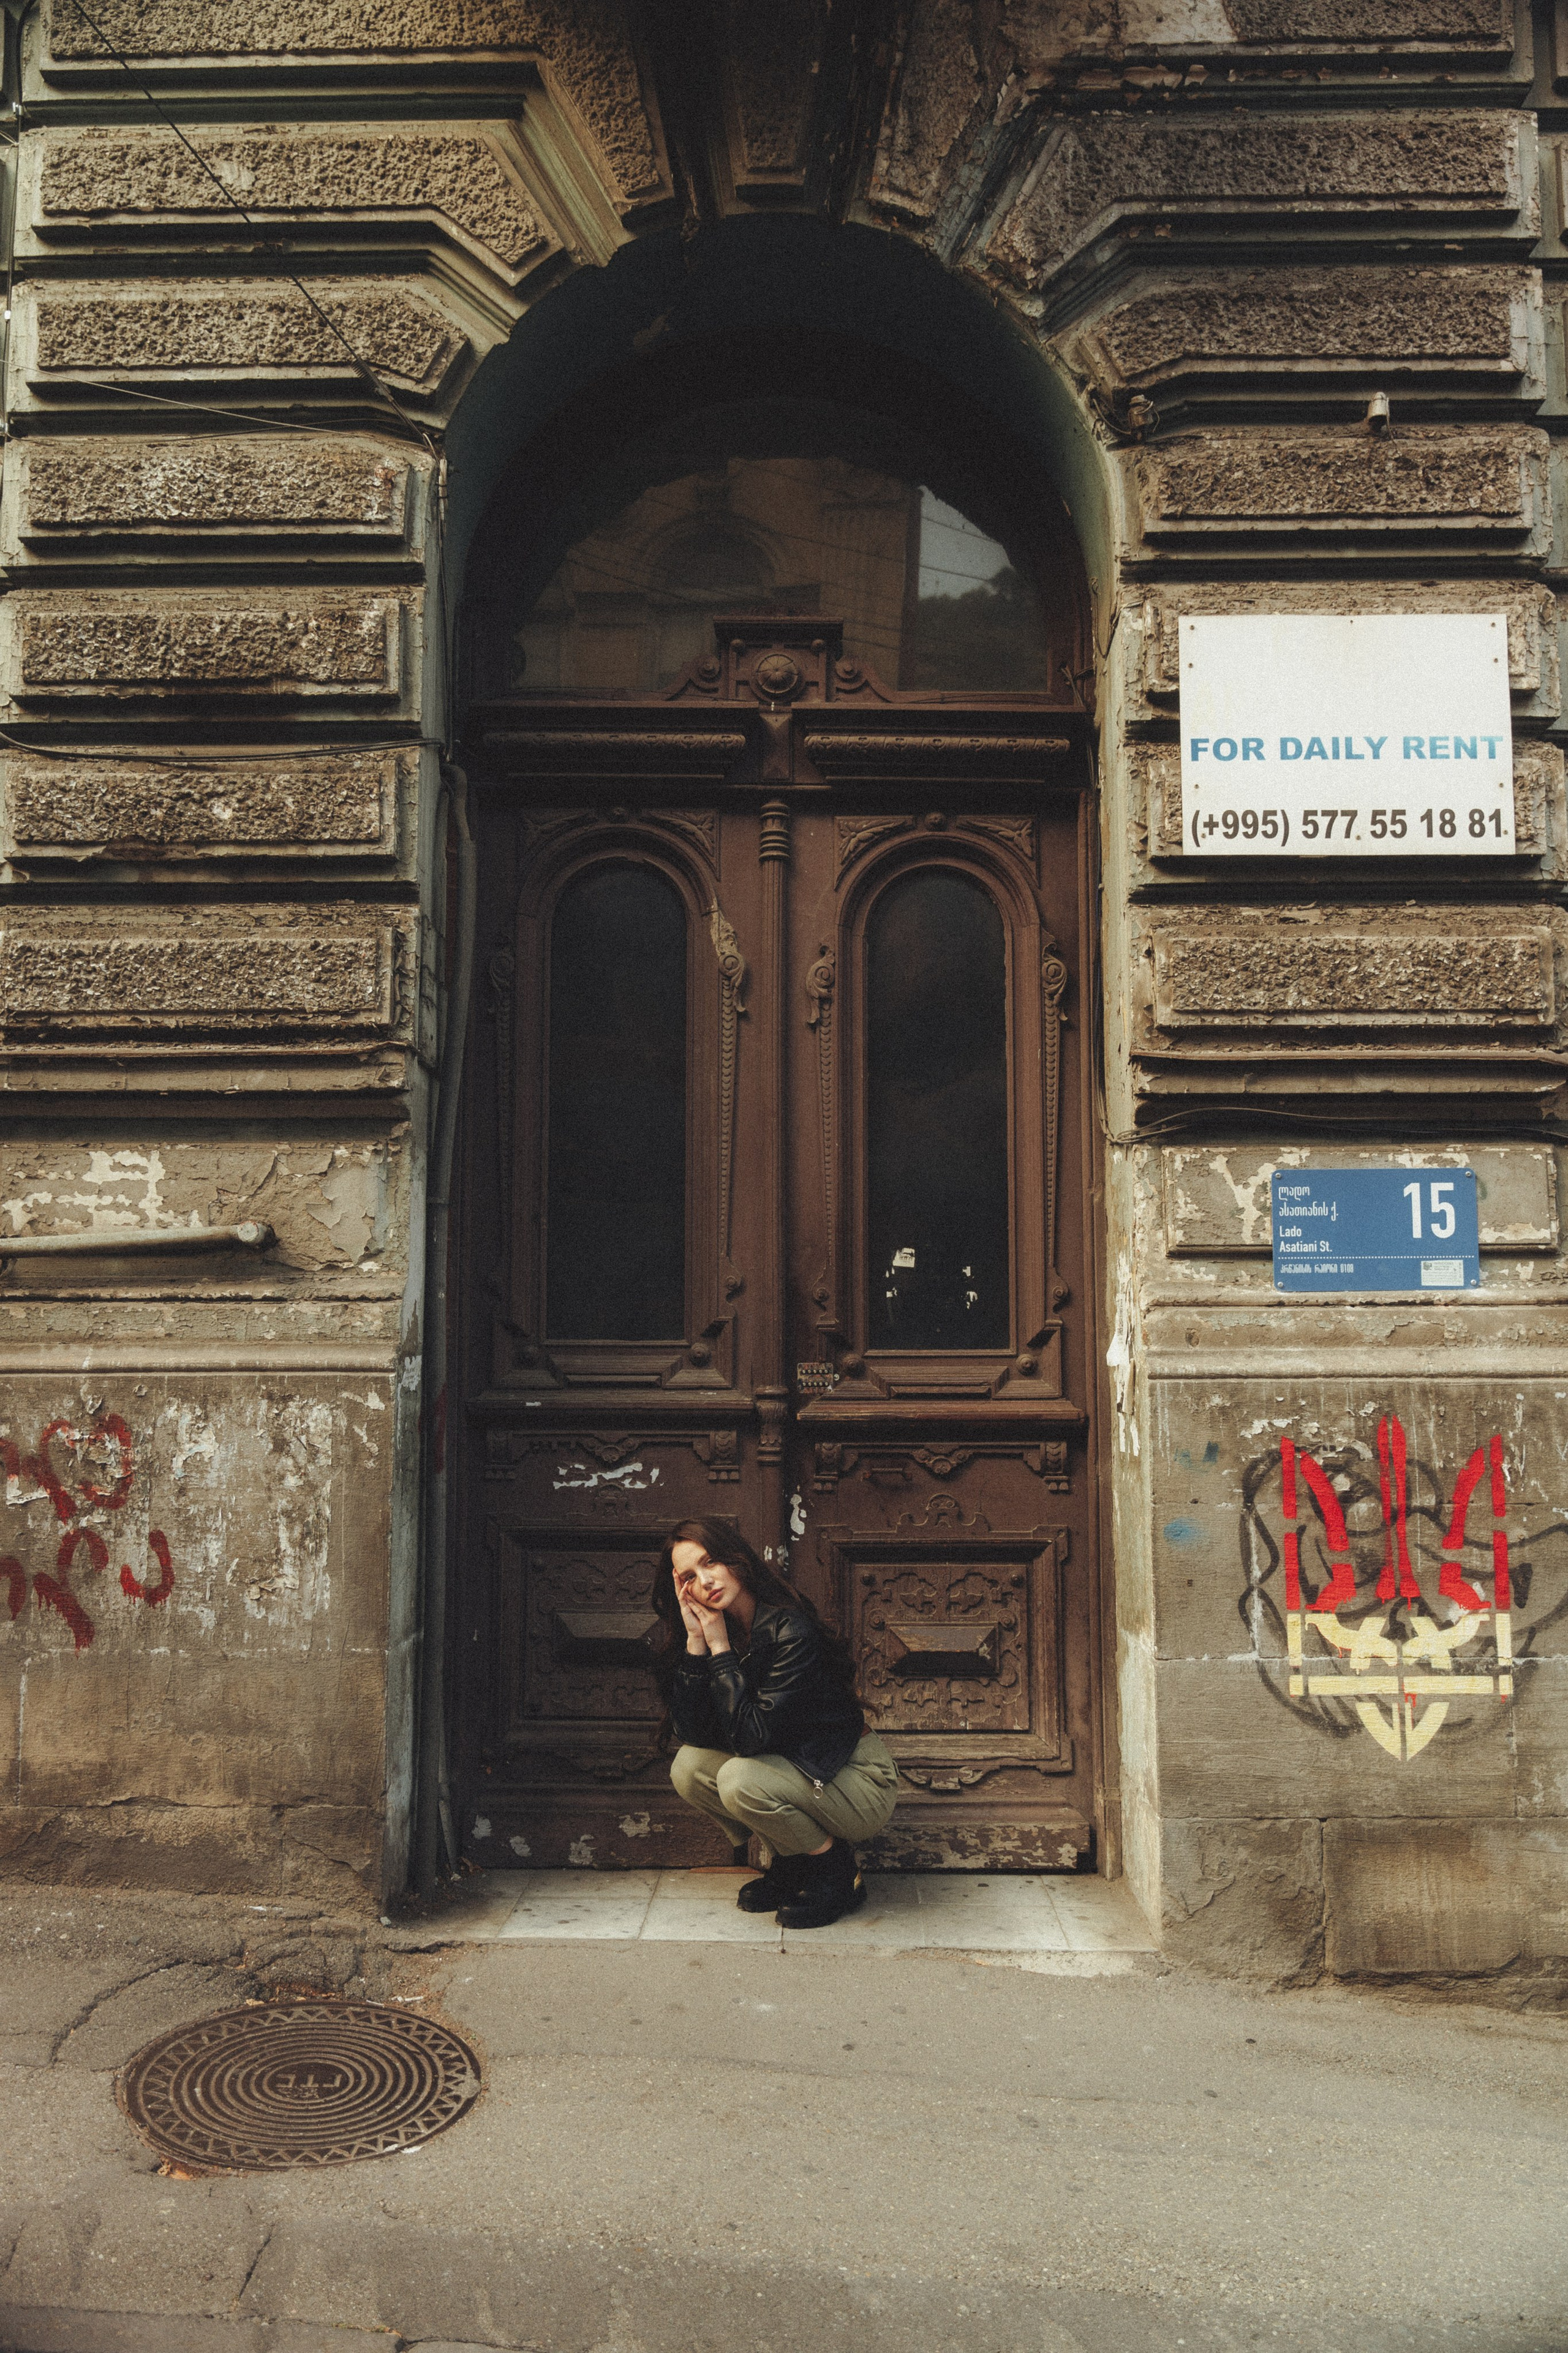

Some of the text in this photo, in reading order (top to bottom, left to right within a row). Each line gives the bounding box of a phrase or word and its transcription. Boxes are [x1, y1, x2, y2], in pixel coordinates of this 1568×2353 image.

[1190, 736, 1504, 762] FOR DAILY RENT
[1191, 808, 1503, 847] (+995) 577 55 18 81
[1278, 1186, 1310, 1201] ლადო
[1279, 1201, 1339, 1221] ასათიანის ქ.
[1403, 1182, 1456, 1238] 15
[1280, 1225, 1302, 1237] Lado
[1280, 1241, 1332, 1252] Asatiani St.
